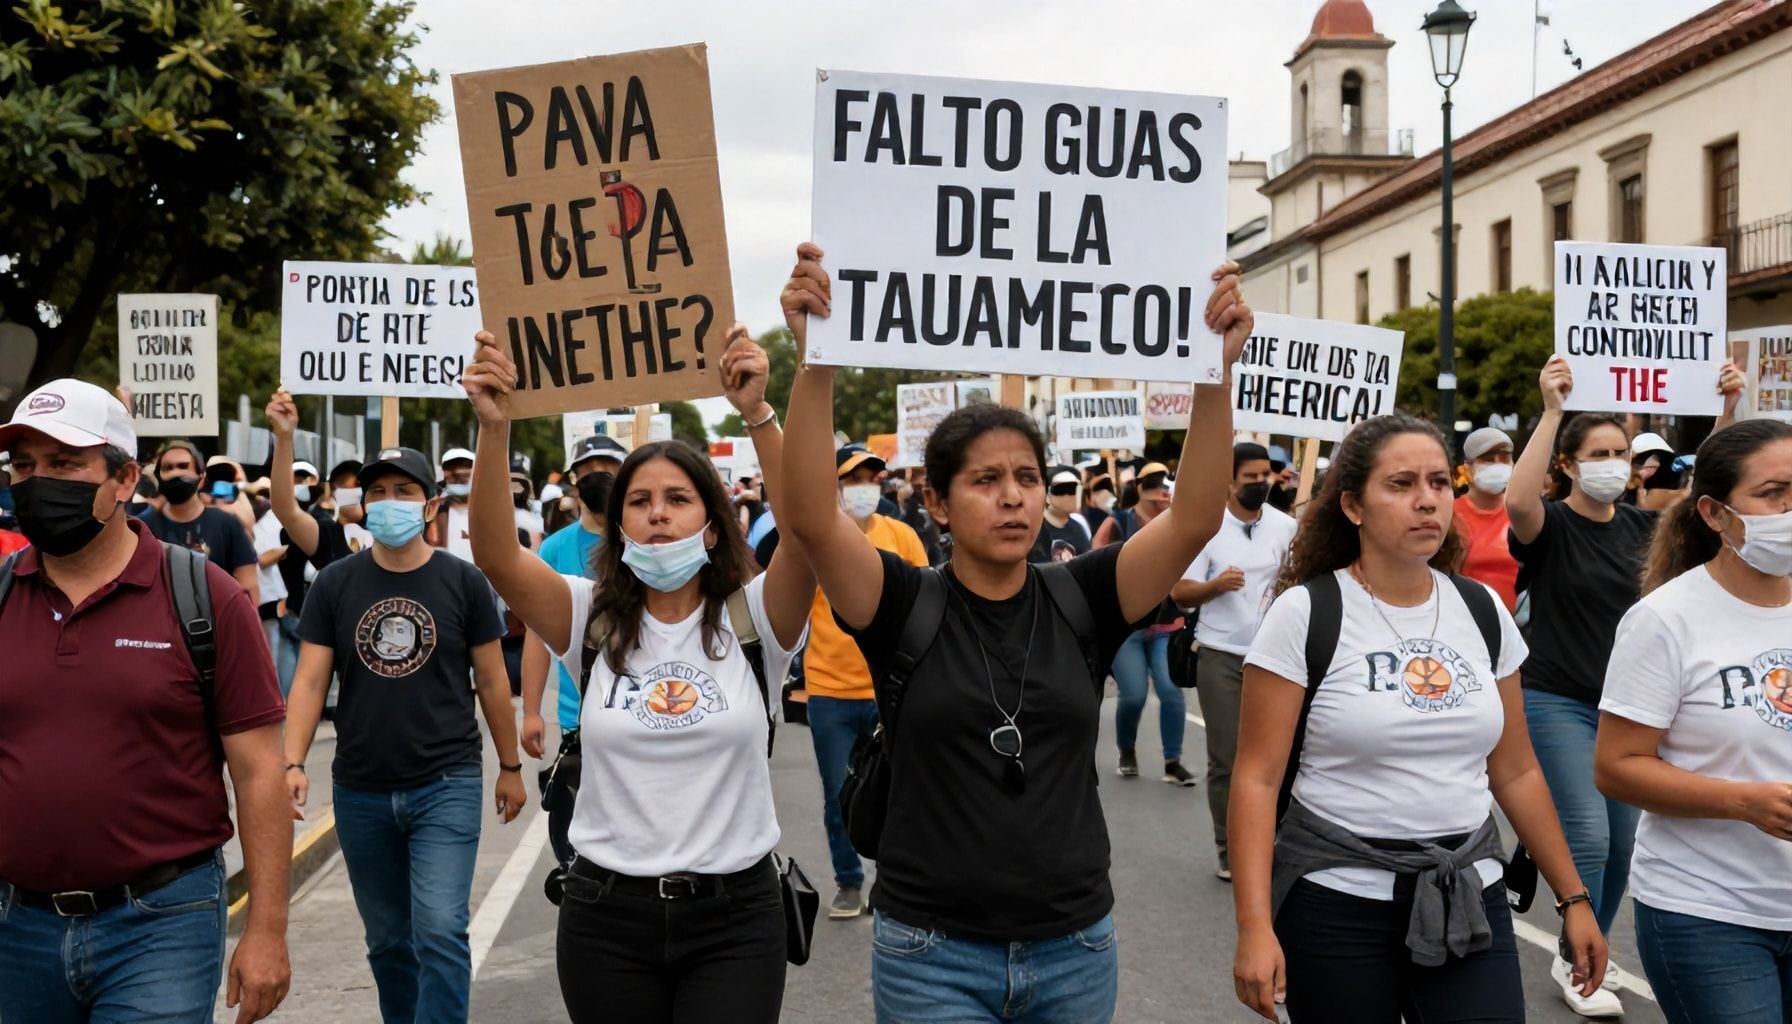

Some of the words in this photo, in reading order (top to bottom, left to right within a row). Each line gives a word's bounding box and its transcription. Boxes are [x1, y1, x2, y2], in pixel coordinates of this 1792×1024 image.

[495, 75, 660, 177] PAVA
[834, 89, 1023, 172] FALTO
[1044, 102, 1202, 183] GUAS
[936, 184, 1015, 260] DE
[1037, 190, 1111, 265] LA
[406, 277, 437, 306] DE
[838, 269, 1192, 358] TAUAMECO!
[300, 351, 346, 381] OLU
[359, 352, 372, 382] E
[1609, 367, 1669, 403] THE
